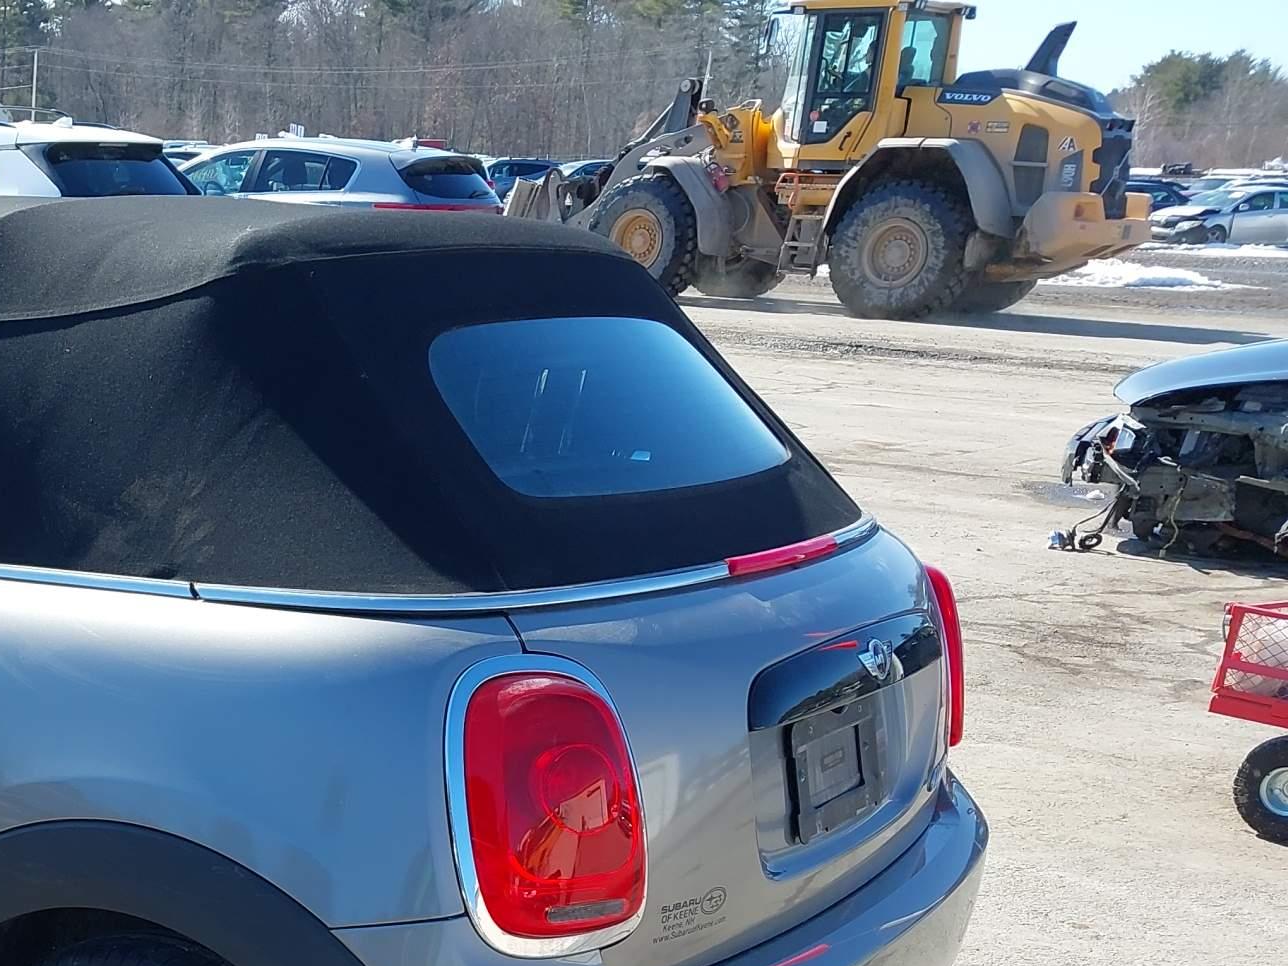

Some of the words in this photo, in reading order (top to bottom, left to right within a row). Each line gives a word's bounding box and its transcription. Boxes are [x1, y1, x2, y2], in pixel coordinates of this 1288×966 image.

[945, 92, 992, 102] VOLVO
[661, 896, 702, 914] SUBARU
[661, 913, 672, 924] OF
[673, 906, 700, 921] KEENE
